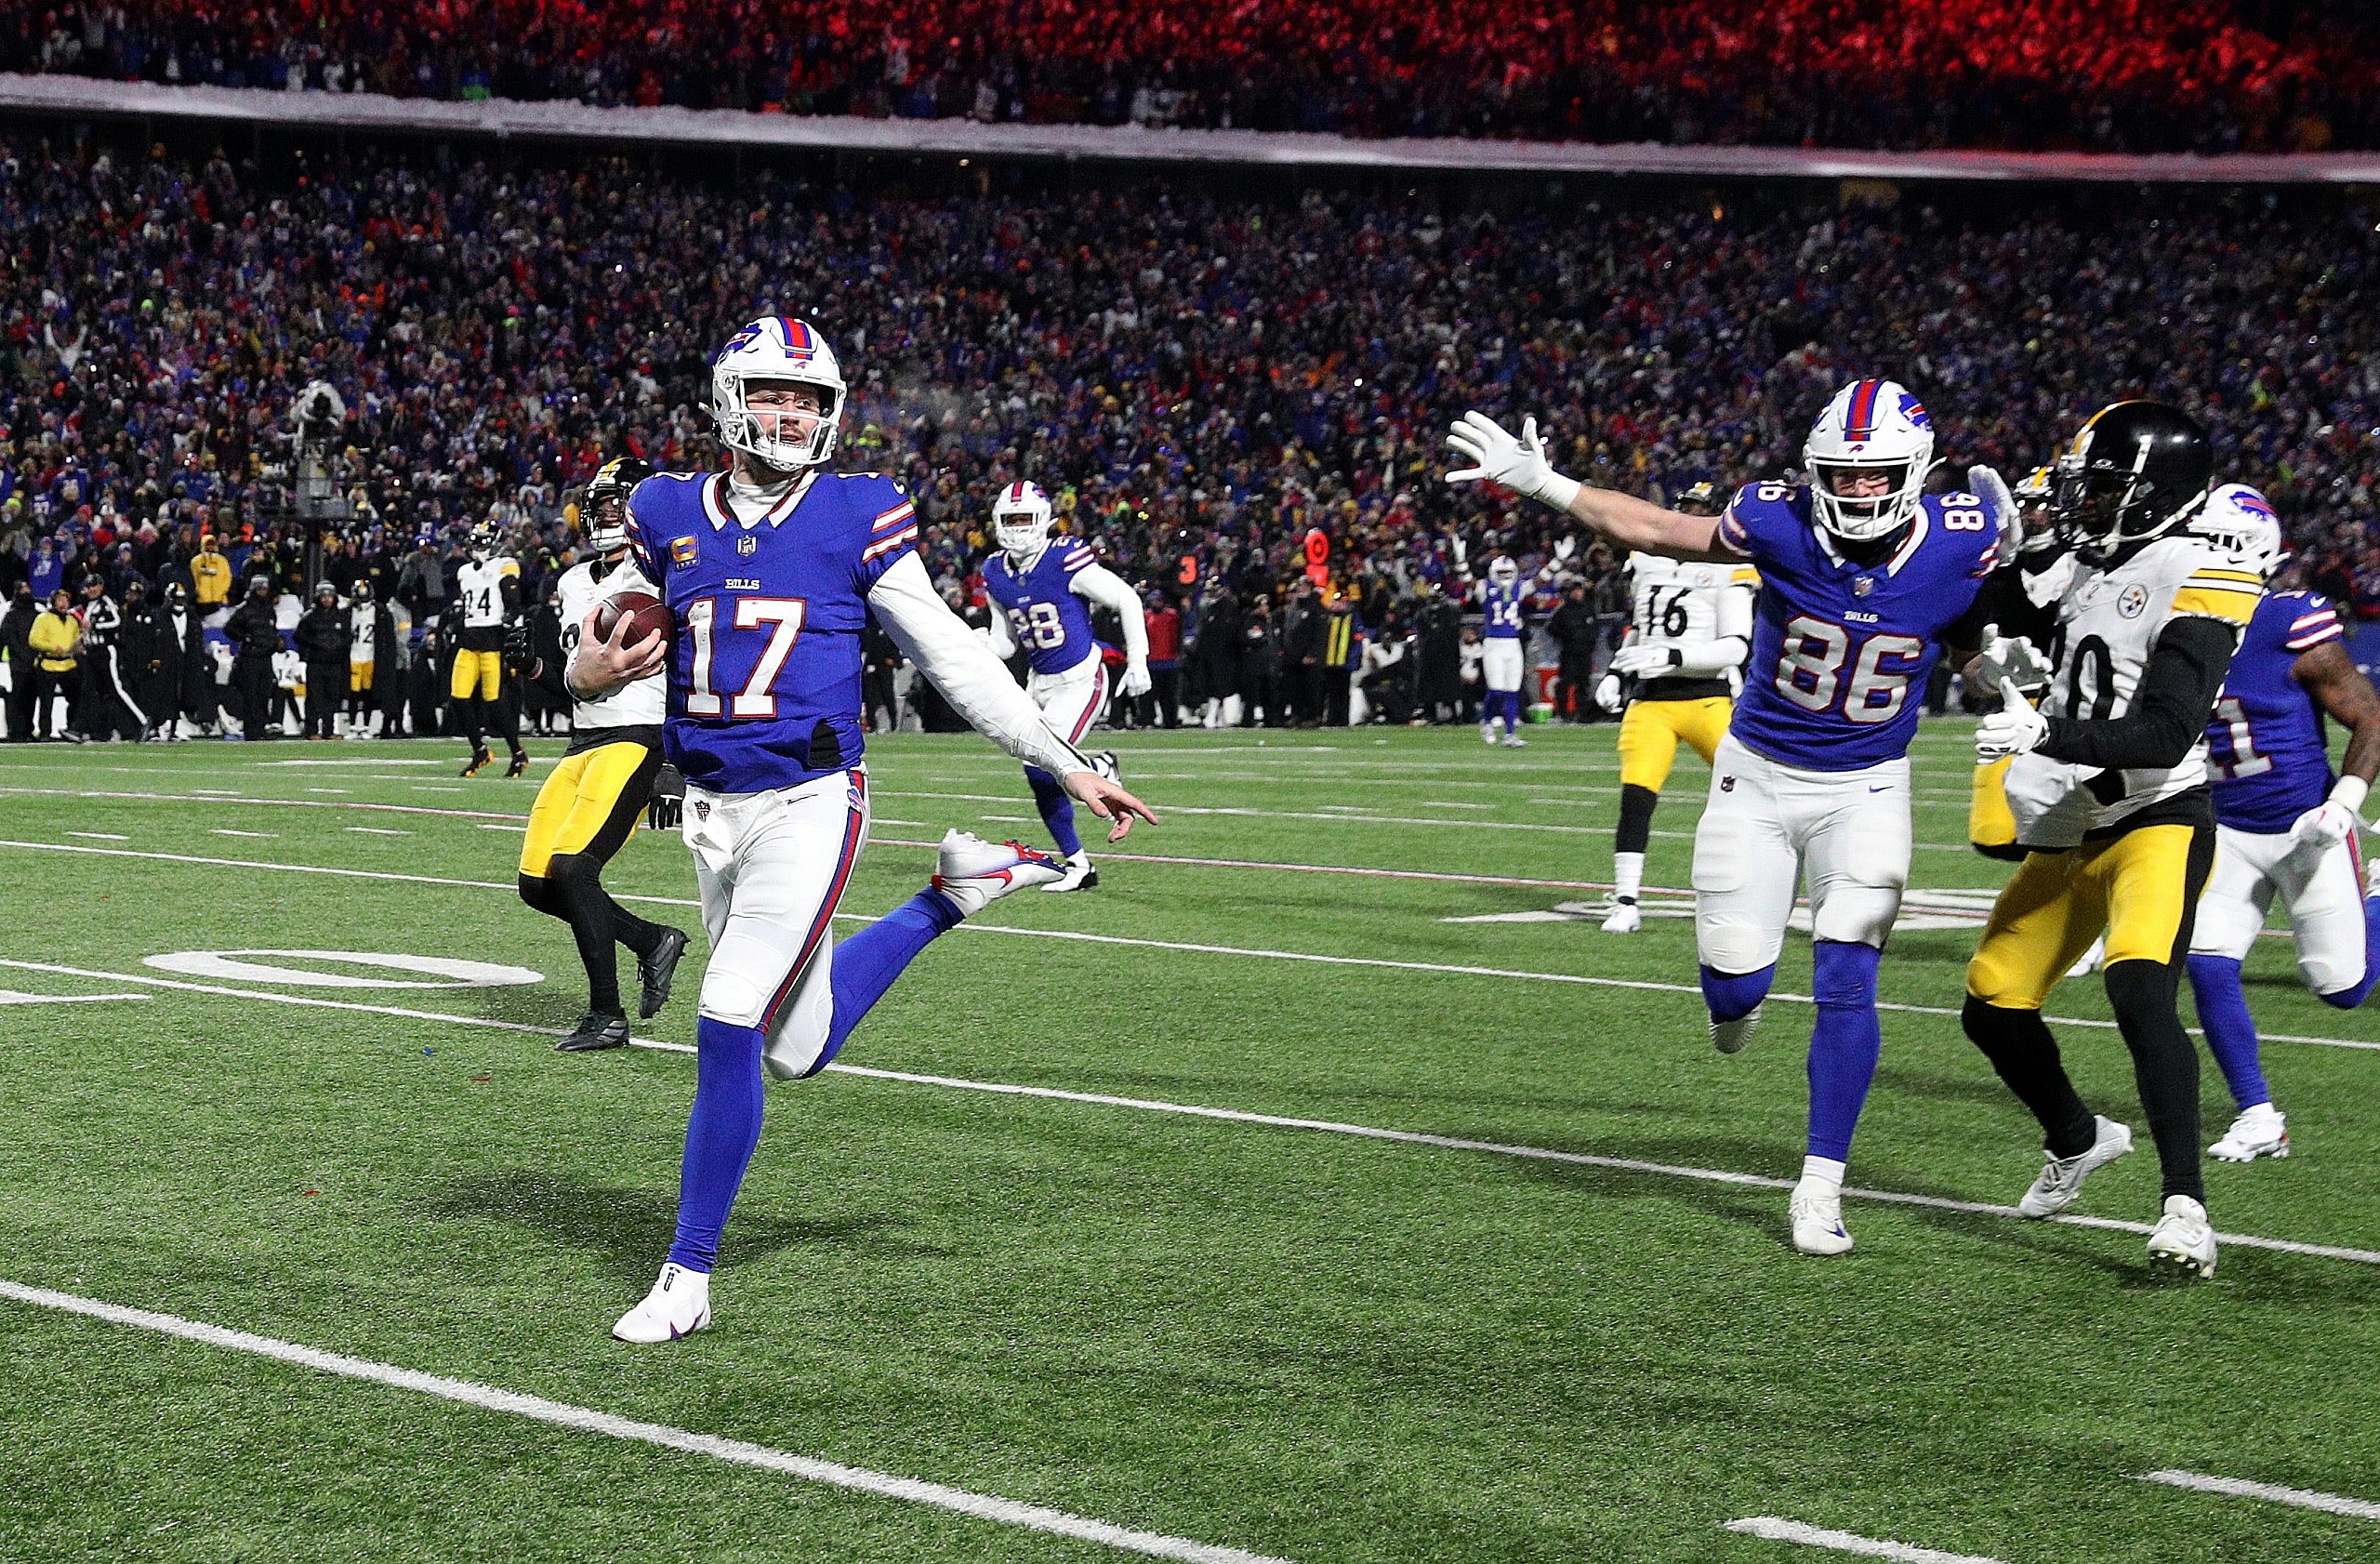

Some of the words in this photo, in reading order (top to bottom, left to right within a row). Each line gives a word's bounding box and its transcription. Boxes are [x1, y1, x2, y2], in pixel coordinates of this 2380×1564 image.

[671, 537, 696, 562] C
[725, 578, 760, 590] BILLS
[1178, 555, 1197, 585] 3
[1491, 601, 1519, 626] 14
[1647, 585, 1694, 638] 16
[1844, 610, 1879, 624] BILLS
[685, 597, 806, 719] 17
[1775, 615, 1924, 723] 86
[141, 949, 546, 989] 0
